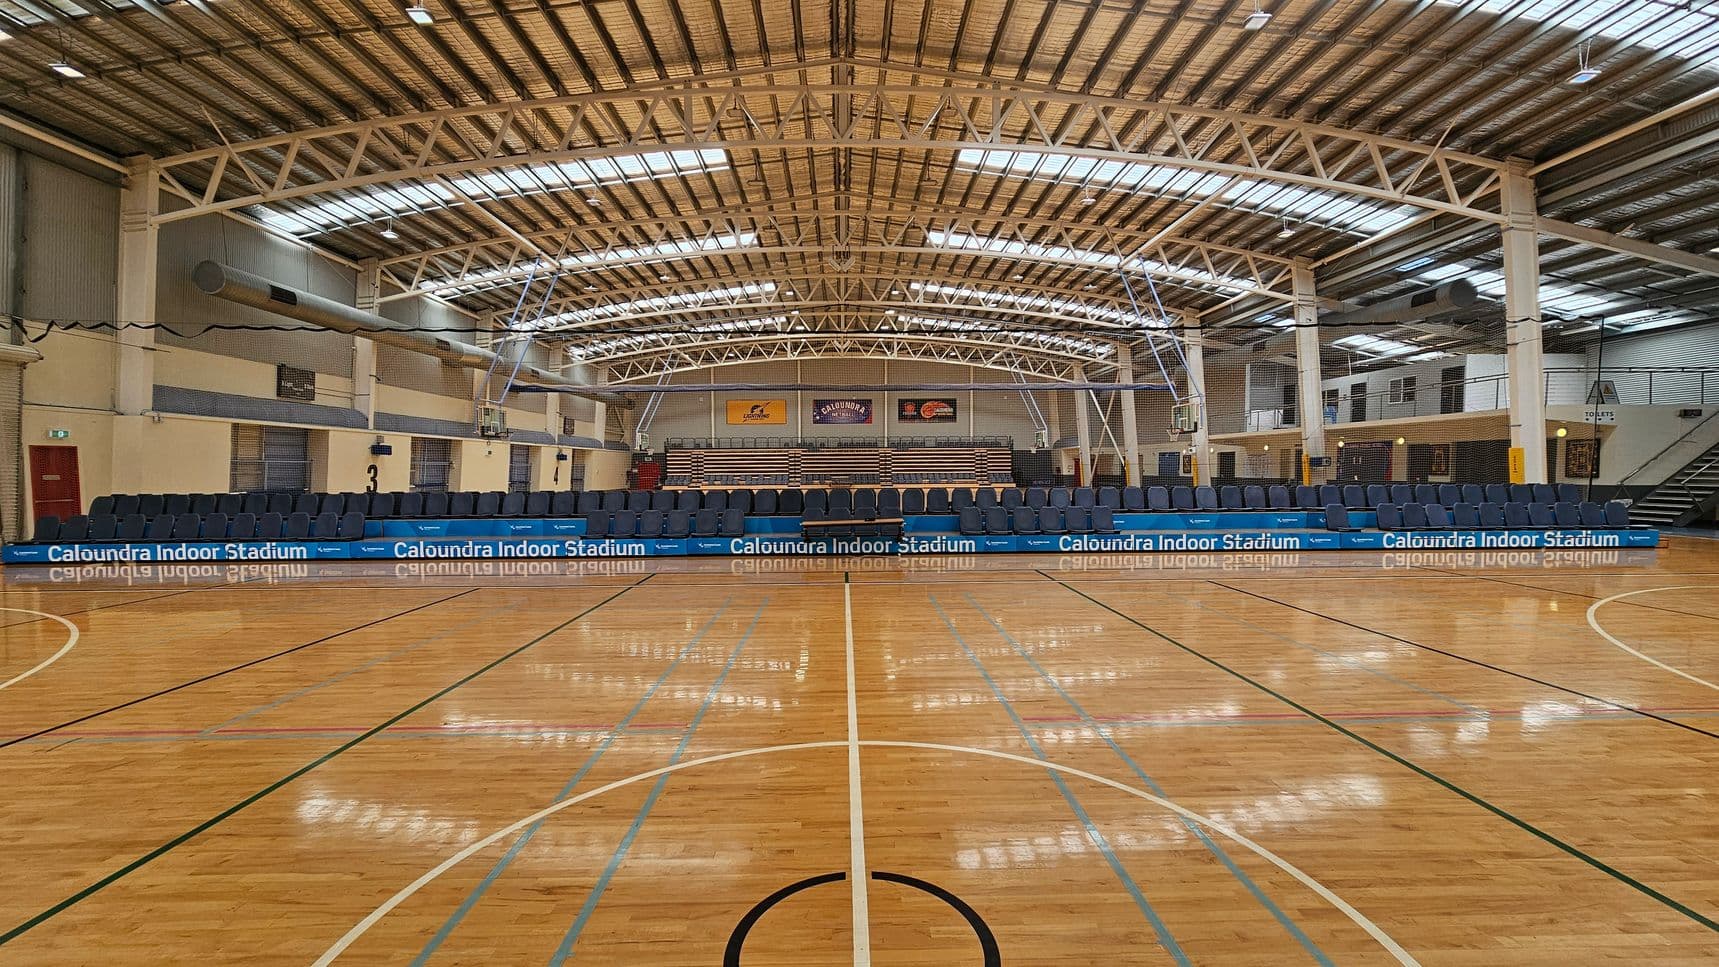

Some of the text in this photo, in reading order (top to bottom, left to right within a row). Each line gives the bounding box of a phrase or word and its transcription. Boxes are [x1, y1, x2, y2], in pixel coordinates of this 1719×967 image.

[821, 401, 866, 415] CALOUNDRA
[366, 464, 378, 493] 3
[394, 539, 645, 558] Caloundra Indoor Stadium
[730, 536, 975, 554] Caloundra Indoor Stadium
[1059, 533, 1299, 551] Caloundra Indoor Stadium
[1382, 530, 1619, 549] Caloundra Indoor Stadium
[48, 542, 307, 562] Caloundra Indoor Stadium
